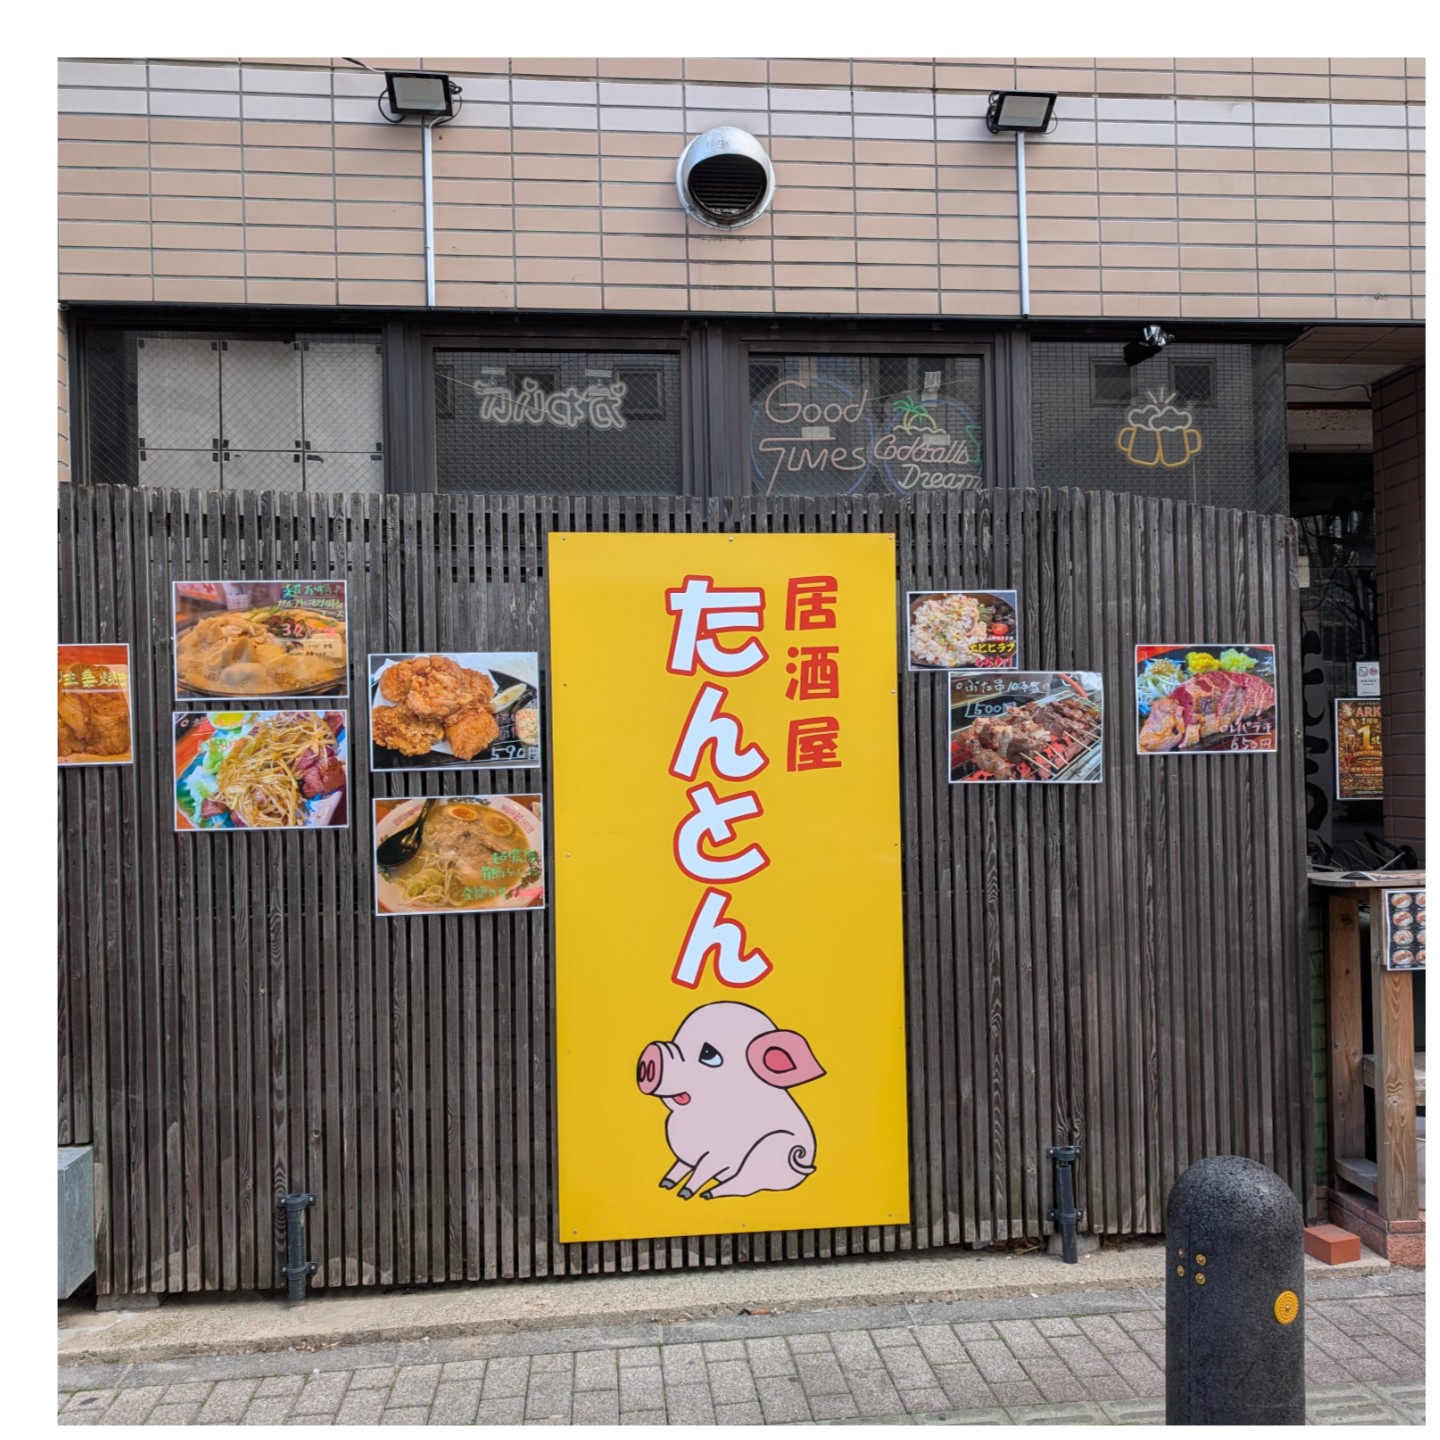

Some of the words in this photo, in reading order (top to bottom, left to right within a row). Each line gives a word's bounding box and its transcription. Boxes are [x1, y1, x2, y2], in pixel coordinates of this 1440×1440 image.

[765, 380, 868, 423] Good
[784, 575, 842, 772] 居酒屋
[664, 574, 774, 990] たんとん
